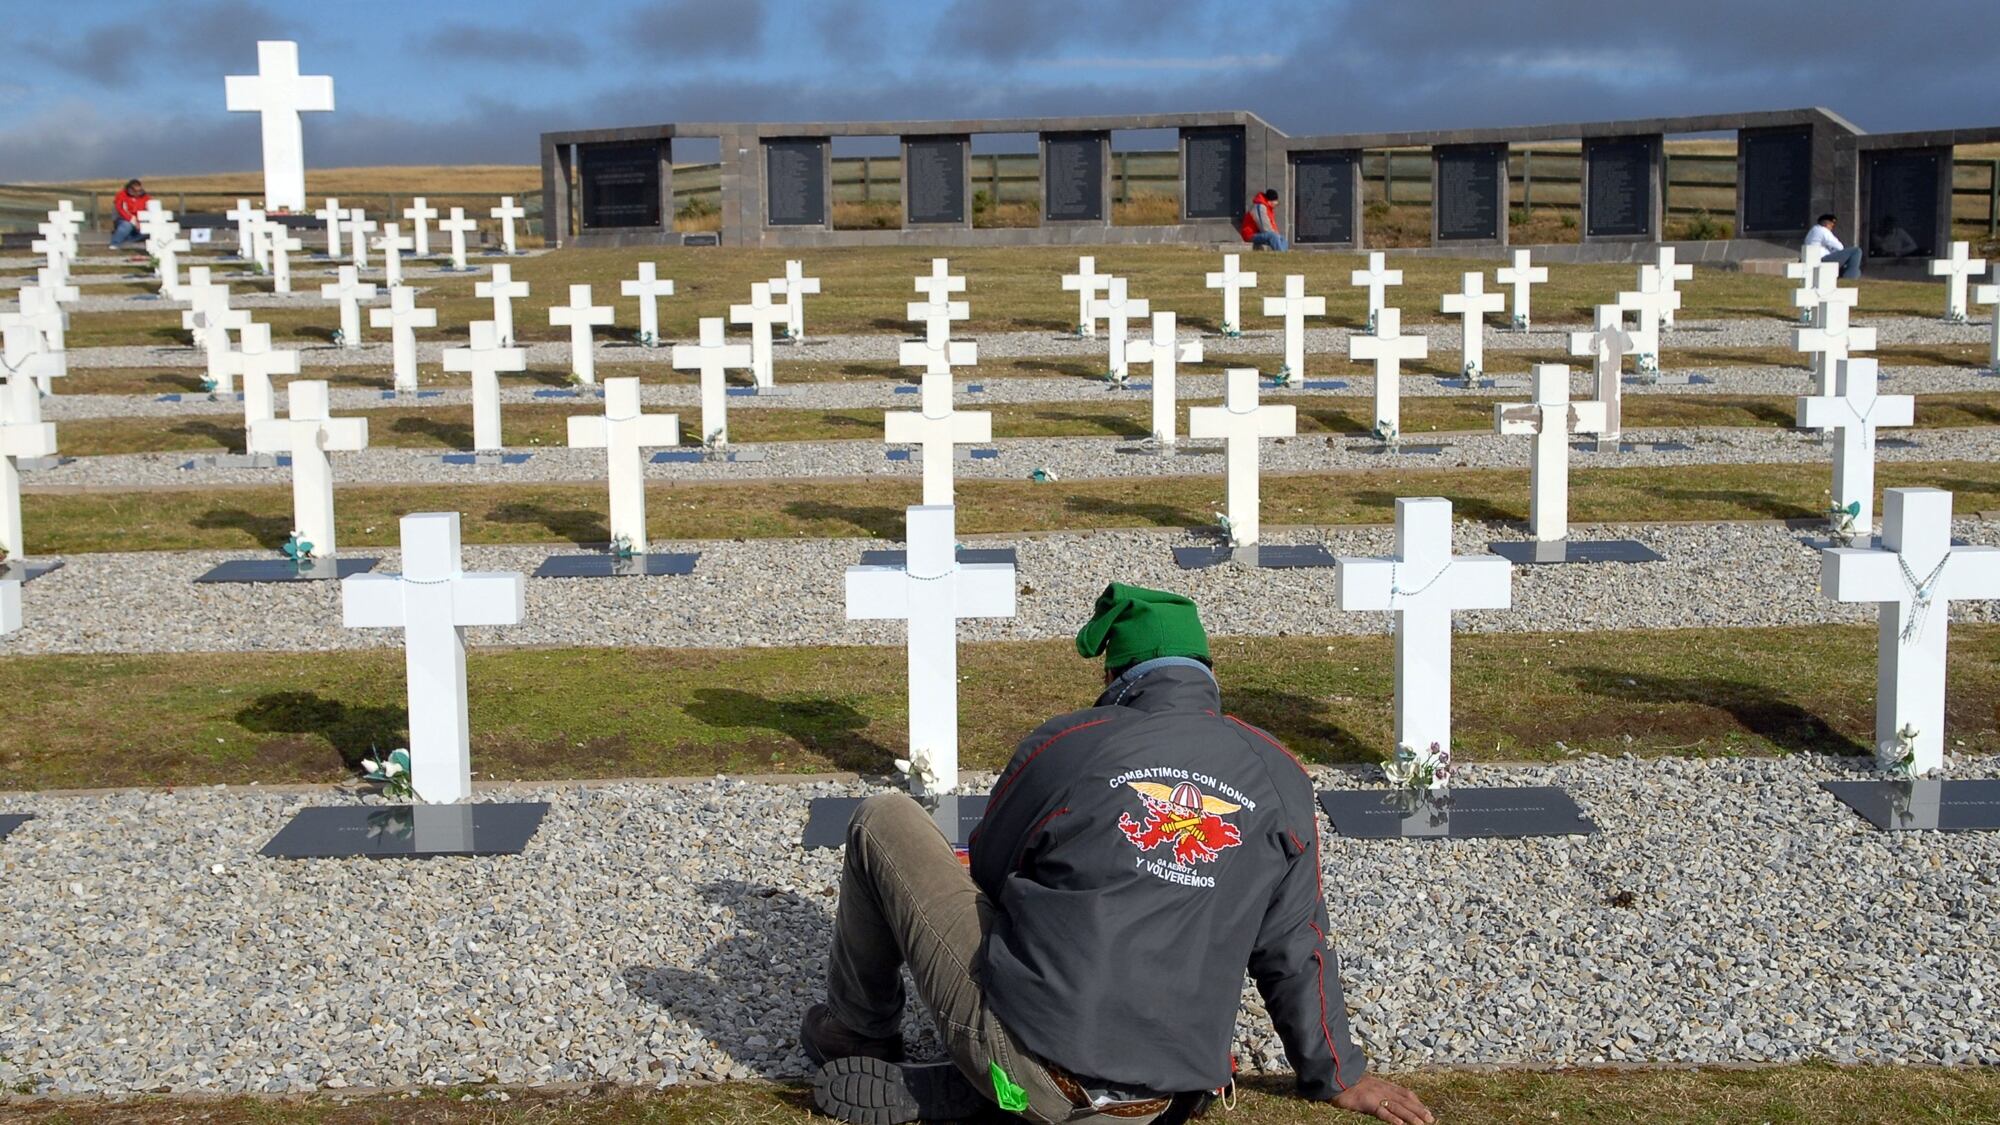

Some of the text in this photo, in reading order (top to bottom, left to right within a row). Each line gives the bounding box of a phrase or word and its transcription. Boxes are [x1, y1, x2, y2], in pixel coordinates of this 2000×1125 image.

[1109, 767, 1256, 811] COMBATIMOS CON HONOR
[1136, 856, 1216, 888] Y VOLVEREMOS
